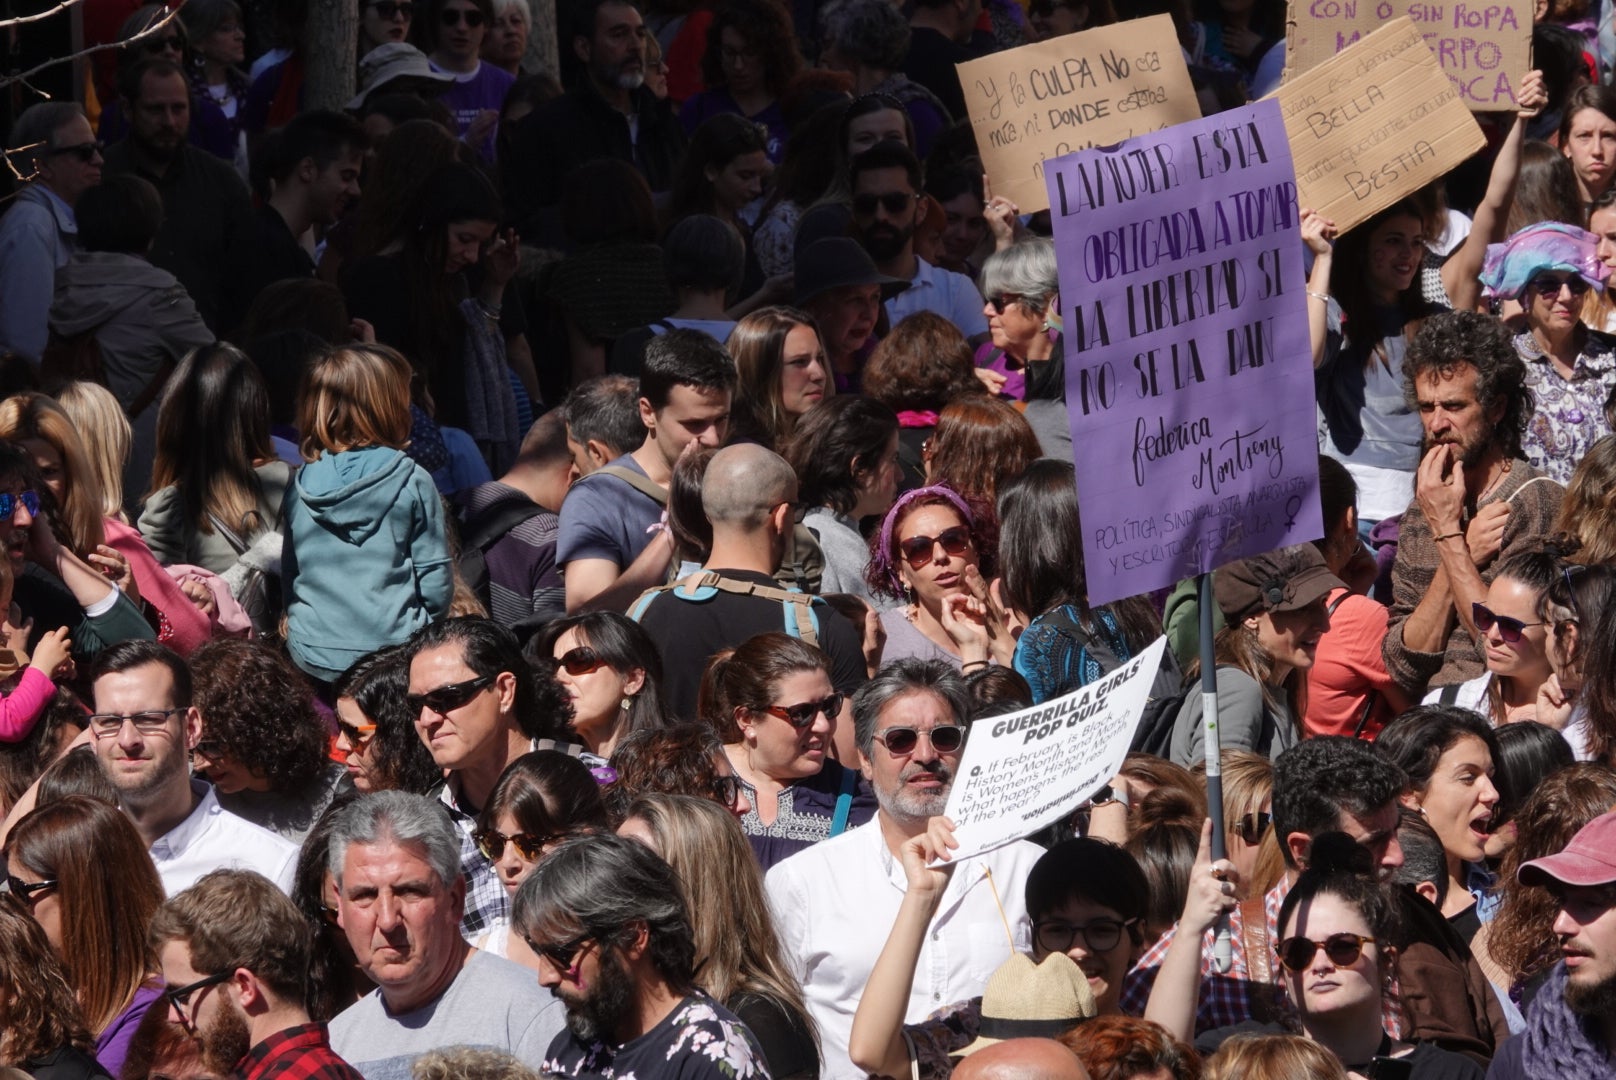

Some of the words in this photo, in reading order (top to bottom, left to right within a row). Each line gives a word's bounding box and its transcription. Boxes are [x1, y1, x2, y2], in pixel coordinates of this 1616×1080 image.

[1310, 0, 1357, 19] CON
[1376, 2, 1394, 20] O
[1407, 4, 1443, 22] SIN
[1454, 5, 1519, 31] ROPA
[1010, 72, 1026, 108] la
[1030, 57, 1097, 101] CULPA
[1136, 51, 1162, 74] era
[1023, 113, 1041, 137] ni
[1048, 98, 1111, 130] DONDE
[1306, 84, 1385, 139] BELLA
[1192, 114, 1269, 180] ESTÁ
[1344, 140, 1435, 200] BESTIA
[1083, 207, 1206, 284] OBLIGADA
[1213, 200, 1232, 250] A
[1229, 181, 1300, 243] TOMAR
[1075, 300, 1110, 354] LA
[1126, 257, 1247, 338] LIBERTAD
[1257, 247, 1284, 301] SI
[1080, 361, 1116, 416] NO
[1133, 348, 1163, 400] SE
[1170, 338, 1206, 390] LA
[1226, 317, 1275, 377] DAN
[1192, 420, 1285, 496] Montseny
[1109, 556, 1119, 576] Y
[970, 766, 983, 777] Q.
[988, 760, 1001, 774] If
[1003, 741, 1063, 769] February
[1068, 732, 1078, 744] is
[1081, 712, 1113, 737] Black
[992, 692, 1089, 738] GUERRILLA
[1022, 717, 1063, 745] POP
[958, 797, 996, 816] what
[999, 774, 1057, 806] happens
[1061, 763, 1081, 779] the
[1084, 745, 1108, 766] rest
[962, 792, 973, 803] is
[1044, 749, 1085, 776] History
[1090, 722, 1128, 755] Month
[966, 769, 1017, 791] History
[1021, 752, 1064, 775] Month
[1068, 736, 1092, 757] and
[1095, 709, 1131, 744] March
[954, 814, 969, 830] of
[973, 807, 997, 825] the
[1000, 790, 1041, 819] year?
